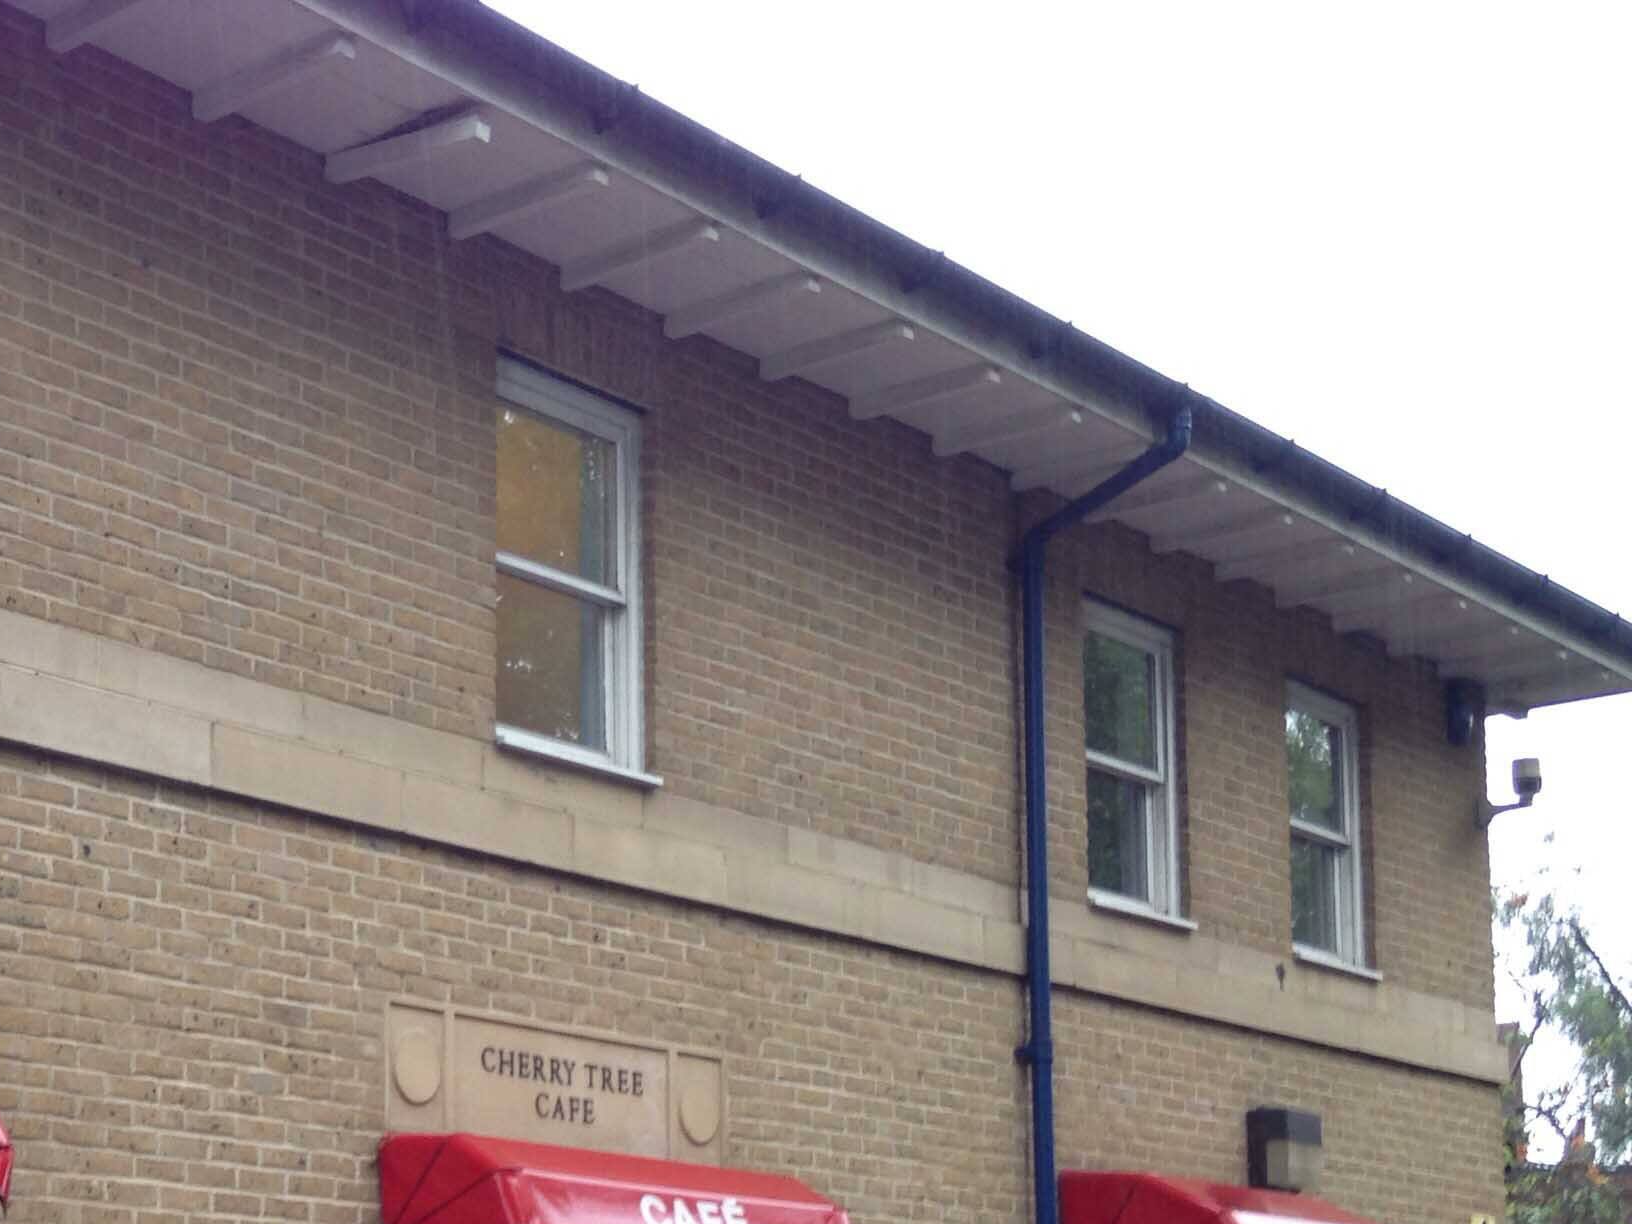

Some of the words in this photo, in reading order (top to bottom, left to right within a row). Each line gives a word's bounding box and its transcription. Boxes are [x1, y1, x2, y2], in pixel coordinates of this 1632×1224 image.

[481, 1047, 576, 1088] CHERRY
[584, 1063, 644, 1097] TREE
[535, 1092, 596, 1124] CAFE
